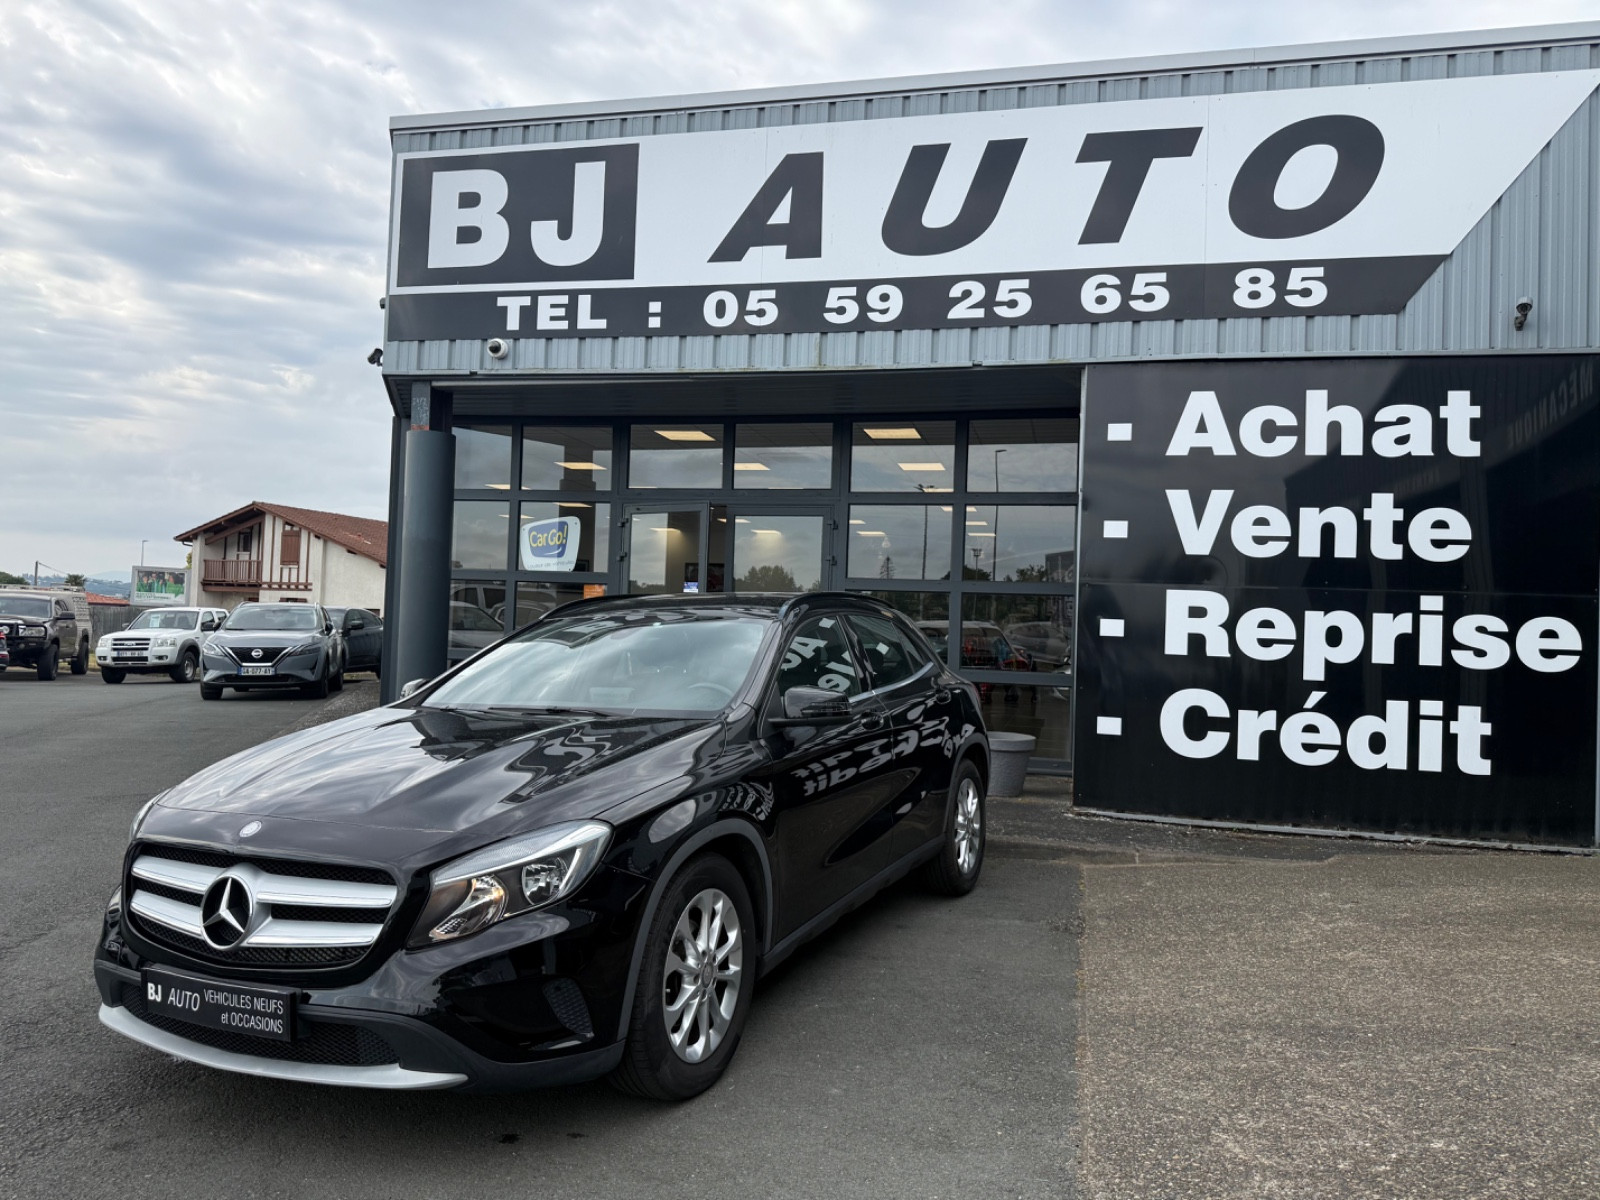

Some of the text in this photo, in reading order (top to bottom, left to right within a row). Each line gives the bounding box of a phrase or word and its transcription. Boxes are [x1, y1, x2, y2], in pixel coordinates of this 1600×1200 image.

[427, 114, 1385, 269] BJ AUTO
[497, 266, 1328, 331] TEL : 05 59 25 65 85
[1165, 389, 1481, 458] Achat
[1165, 489, 1472, 562] Vente
[1164, 589, 1583, 681] Reprise
[1160, 688, 1492, 776] Crédit
[147, 982, 201, 1012] BJ AUTO
[203, 988, 284, 1015] VEHICULES NEUFS
[221, 1012, 284, 1034] et OCCASIONS
